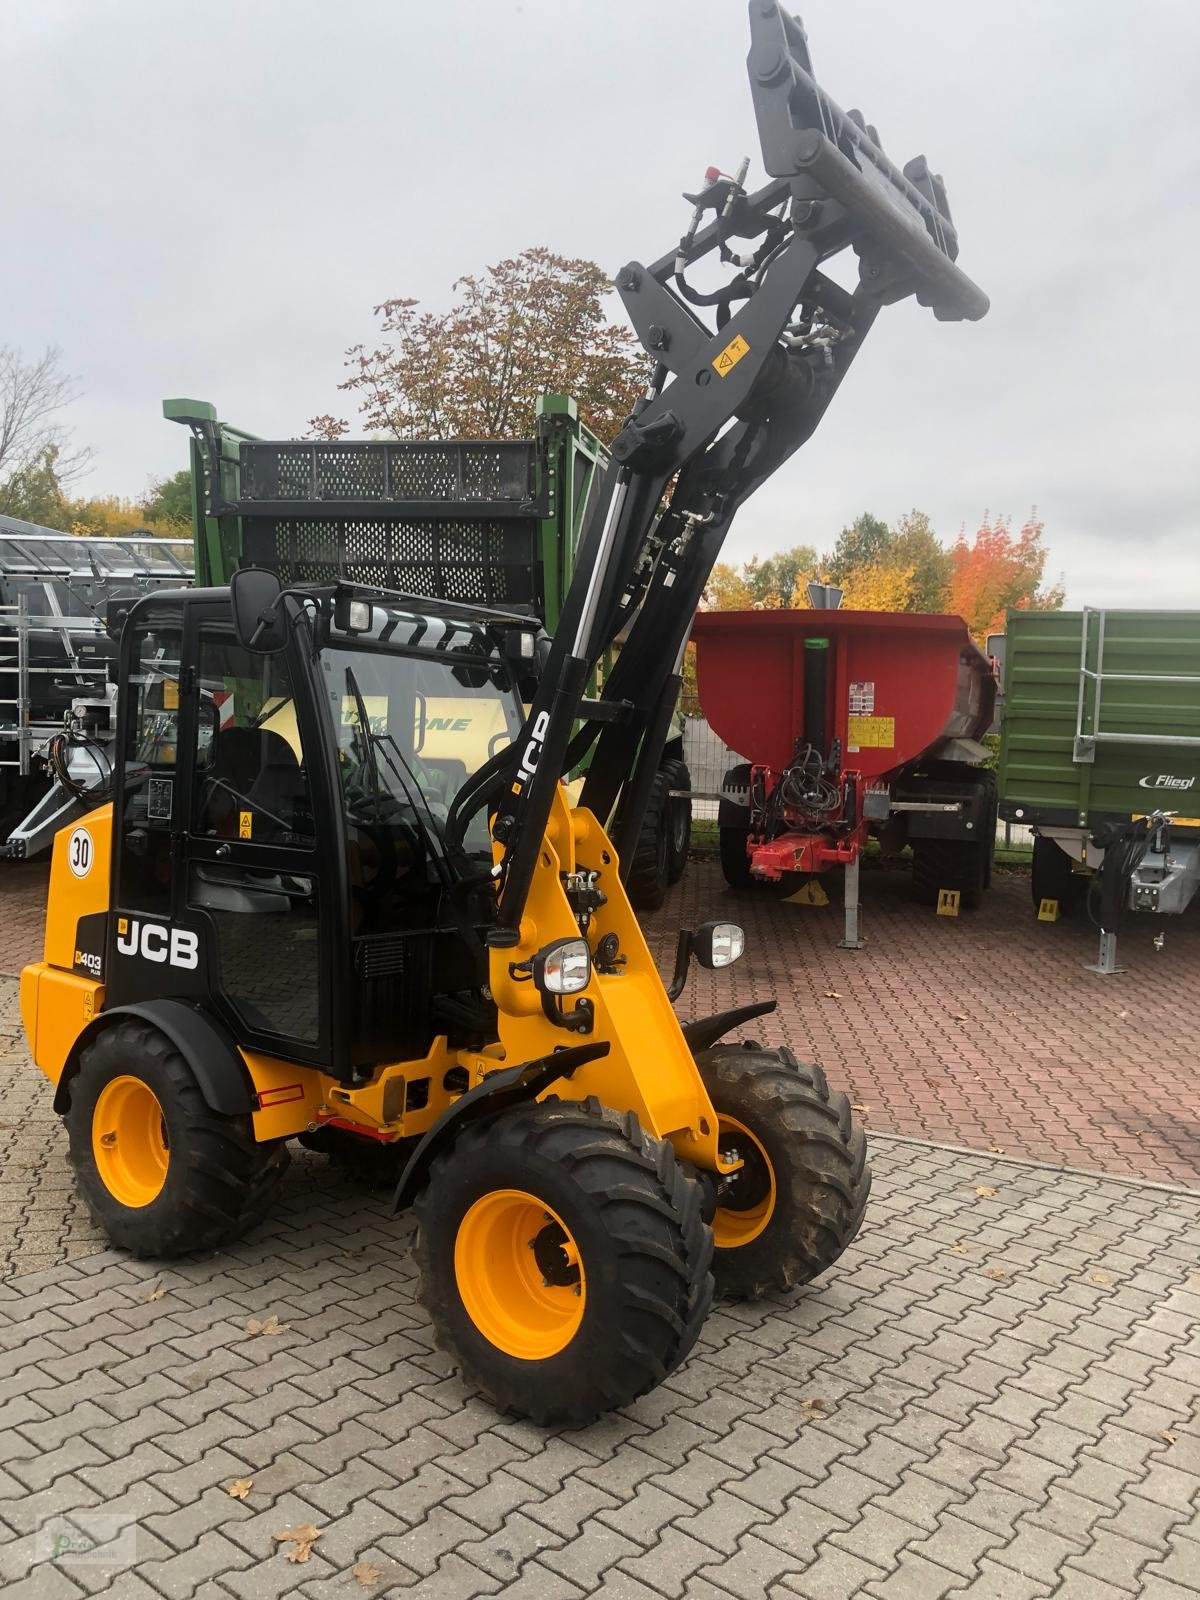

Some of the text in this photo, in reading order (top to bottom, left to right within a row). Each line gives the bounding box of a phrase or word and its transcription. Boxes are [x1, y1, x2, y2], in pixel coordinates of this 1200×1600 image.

[368, 716, 473, 732] KNE
[1156, 775, 1195, 789] Fliegl
[73, 837, 88, 868] 30
[117, 921, 198, 969] JCB
[80, 953, 101, 970] 403
